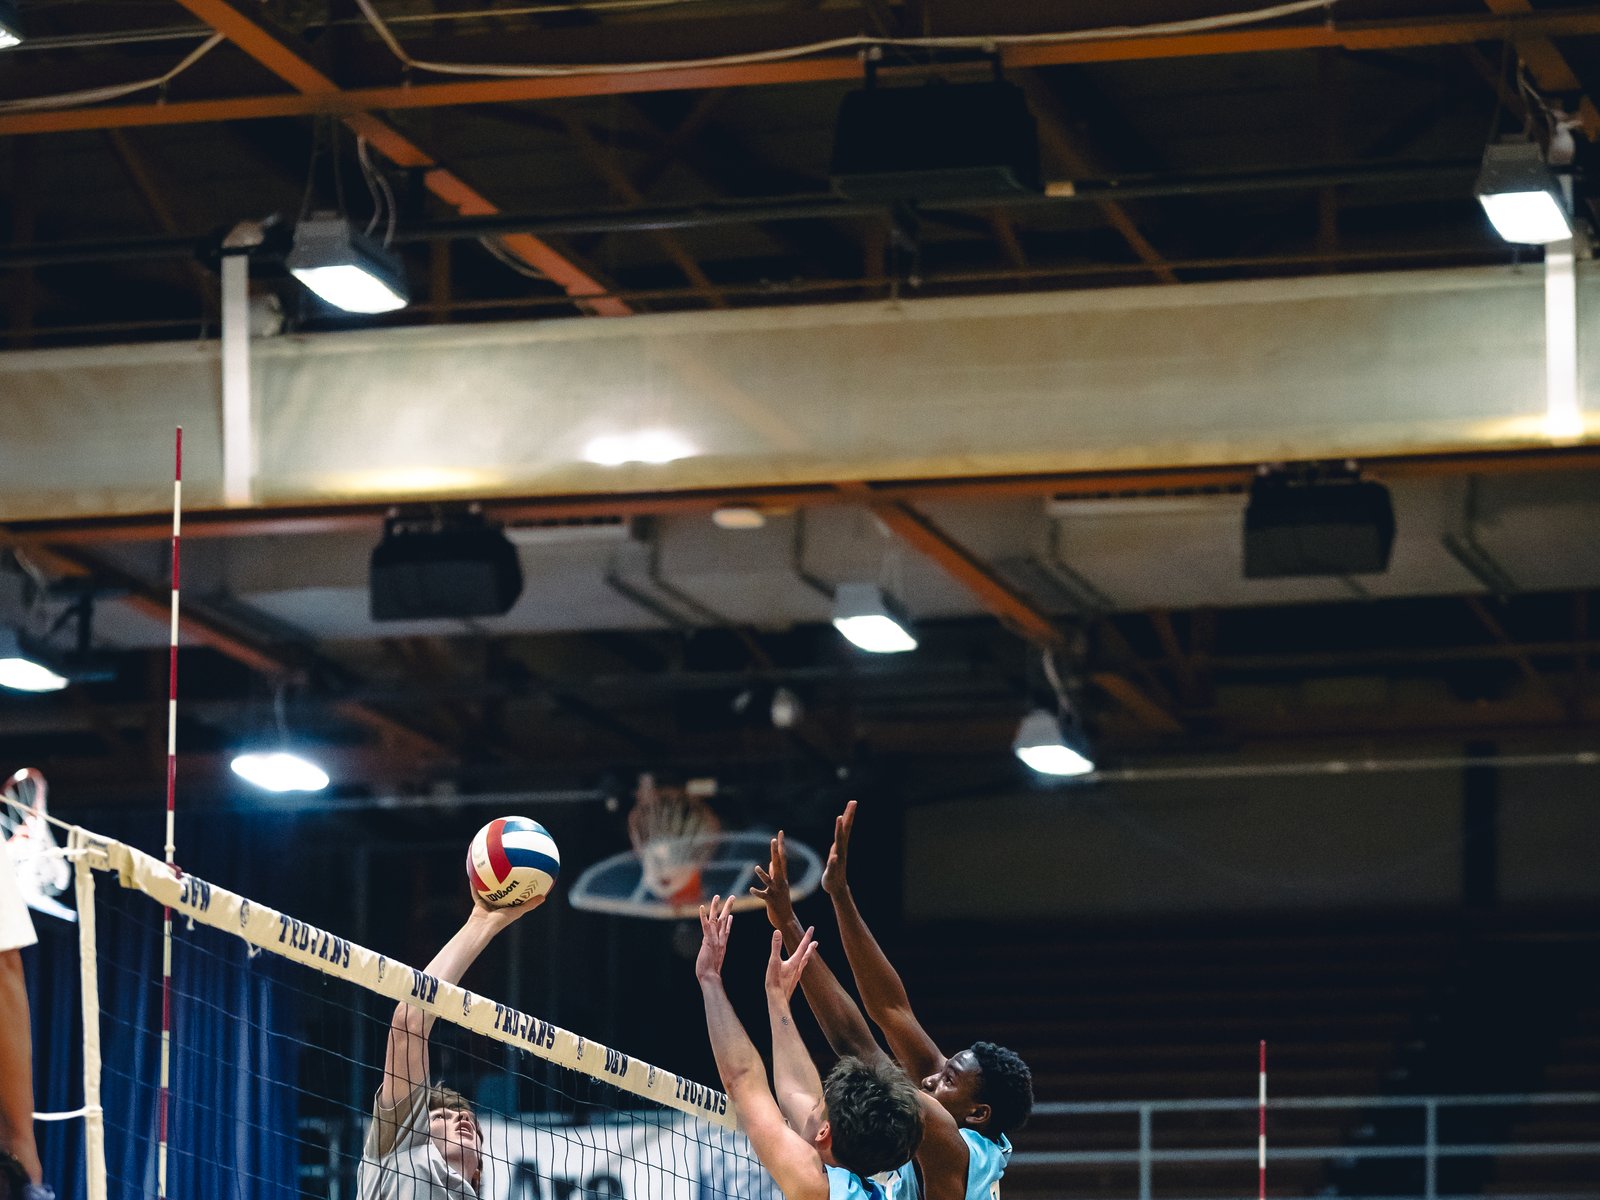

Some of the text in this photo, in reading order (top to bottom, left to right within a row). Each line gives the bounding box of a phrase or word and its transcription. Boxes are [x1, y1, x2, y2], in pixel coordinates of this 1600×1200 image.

[485, 880, 520, 902] Wilson
[278, 914, 351, 969] TROJANS
[410, 967, 439, 1004] DGN
[494, 1002, 556, 1050] TROJANS
[604, 1047, 629, 1077] DGN
[675, 1075, 728, 1116] TROJANS
